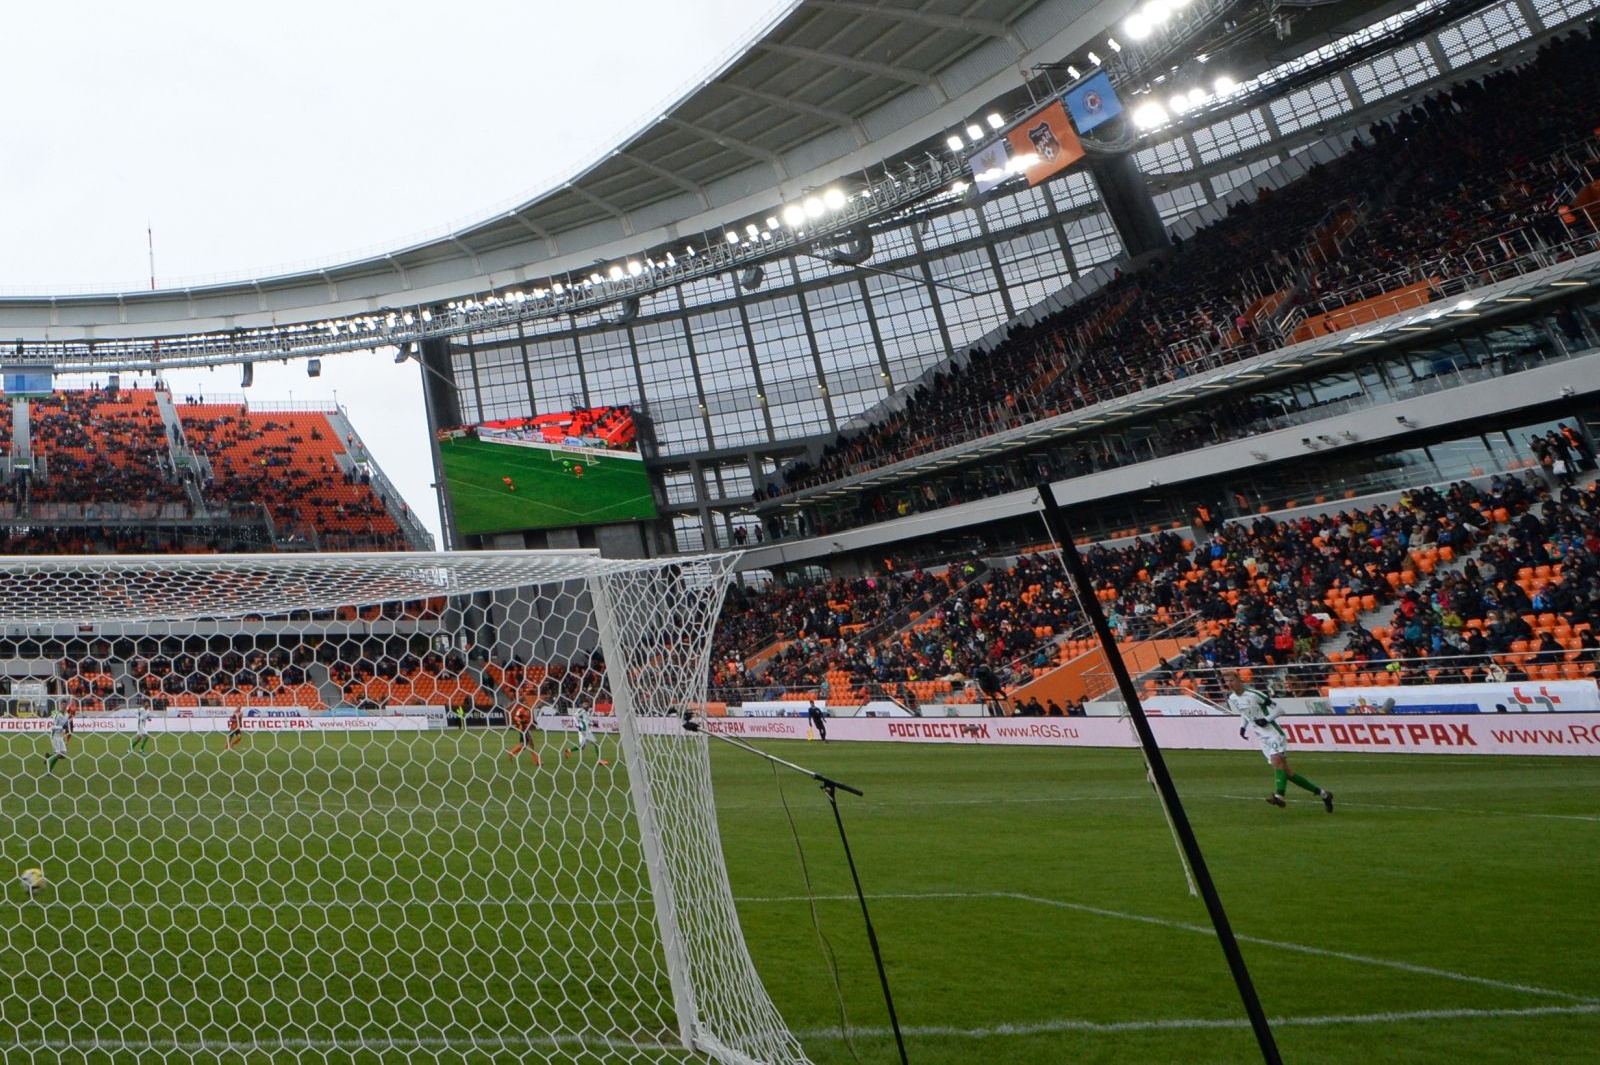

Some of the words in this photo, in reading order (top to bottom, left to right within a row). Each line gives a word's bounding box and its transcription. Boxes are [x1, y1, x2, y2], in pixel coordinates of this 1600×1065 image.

[749, 723, 795, 734] www.RGS.ru
[888, 723, 991, 739] РОСГОССТРАХ
[997, 724, 1079, 739] www.RGS.ru
[1280, 723, 1478, 746] ОСГОССТРАХ
